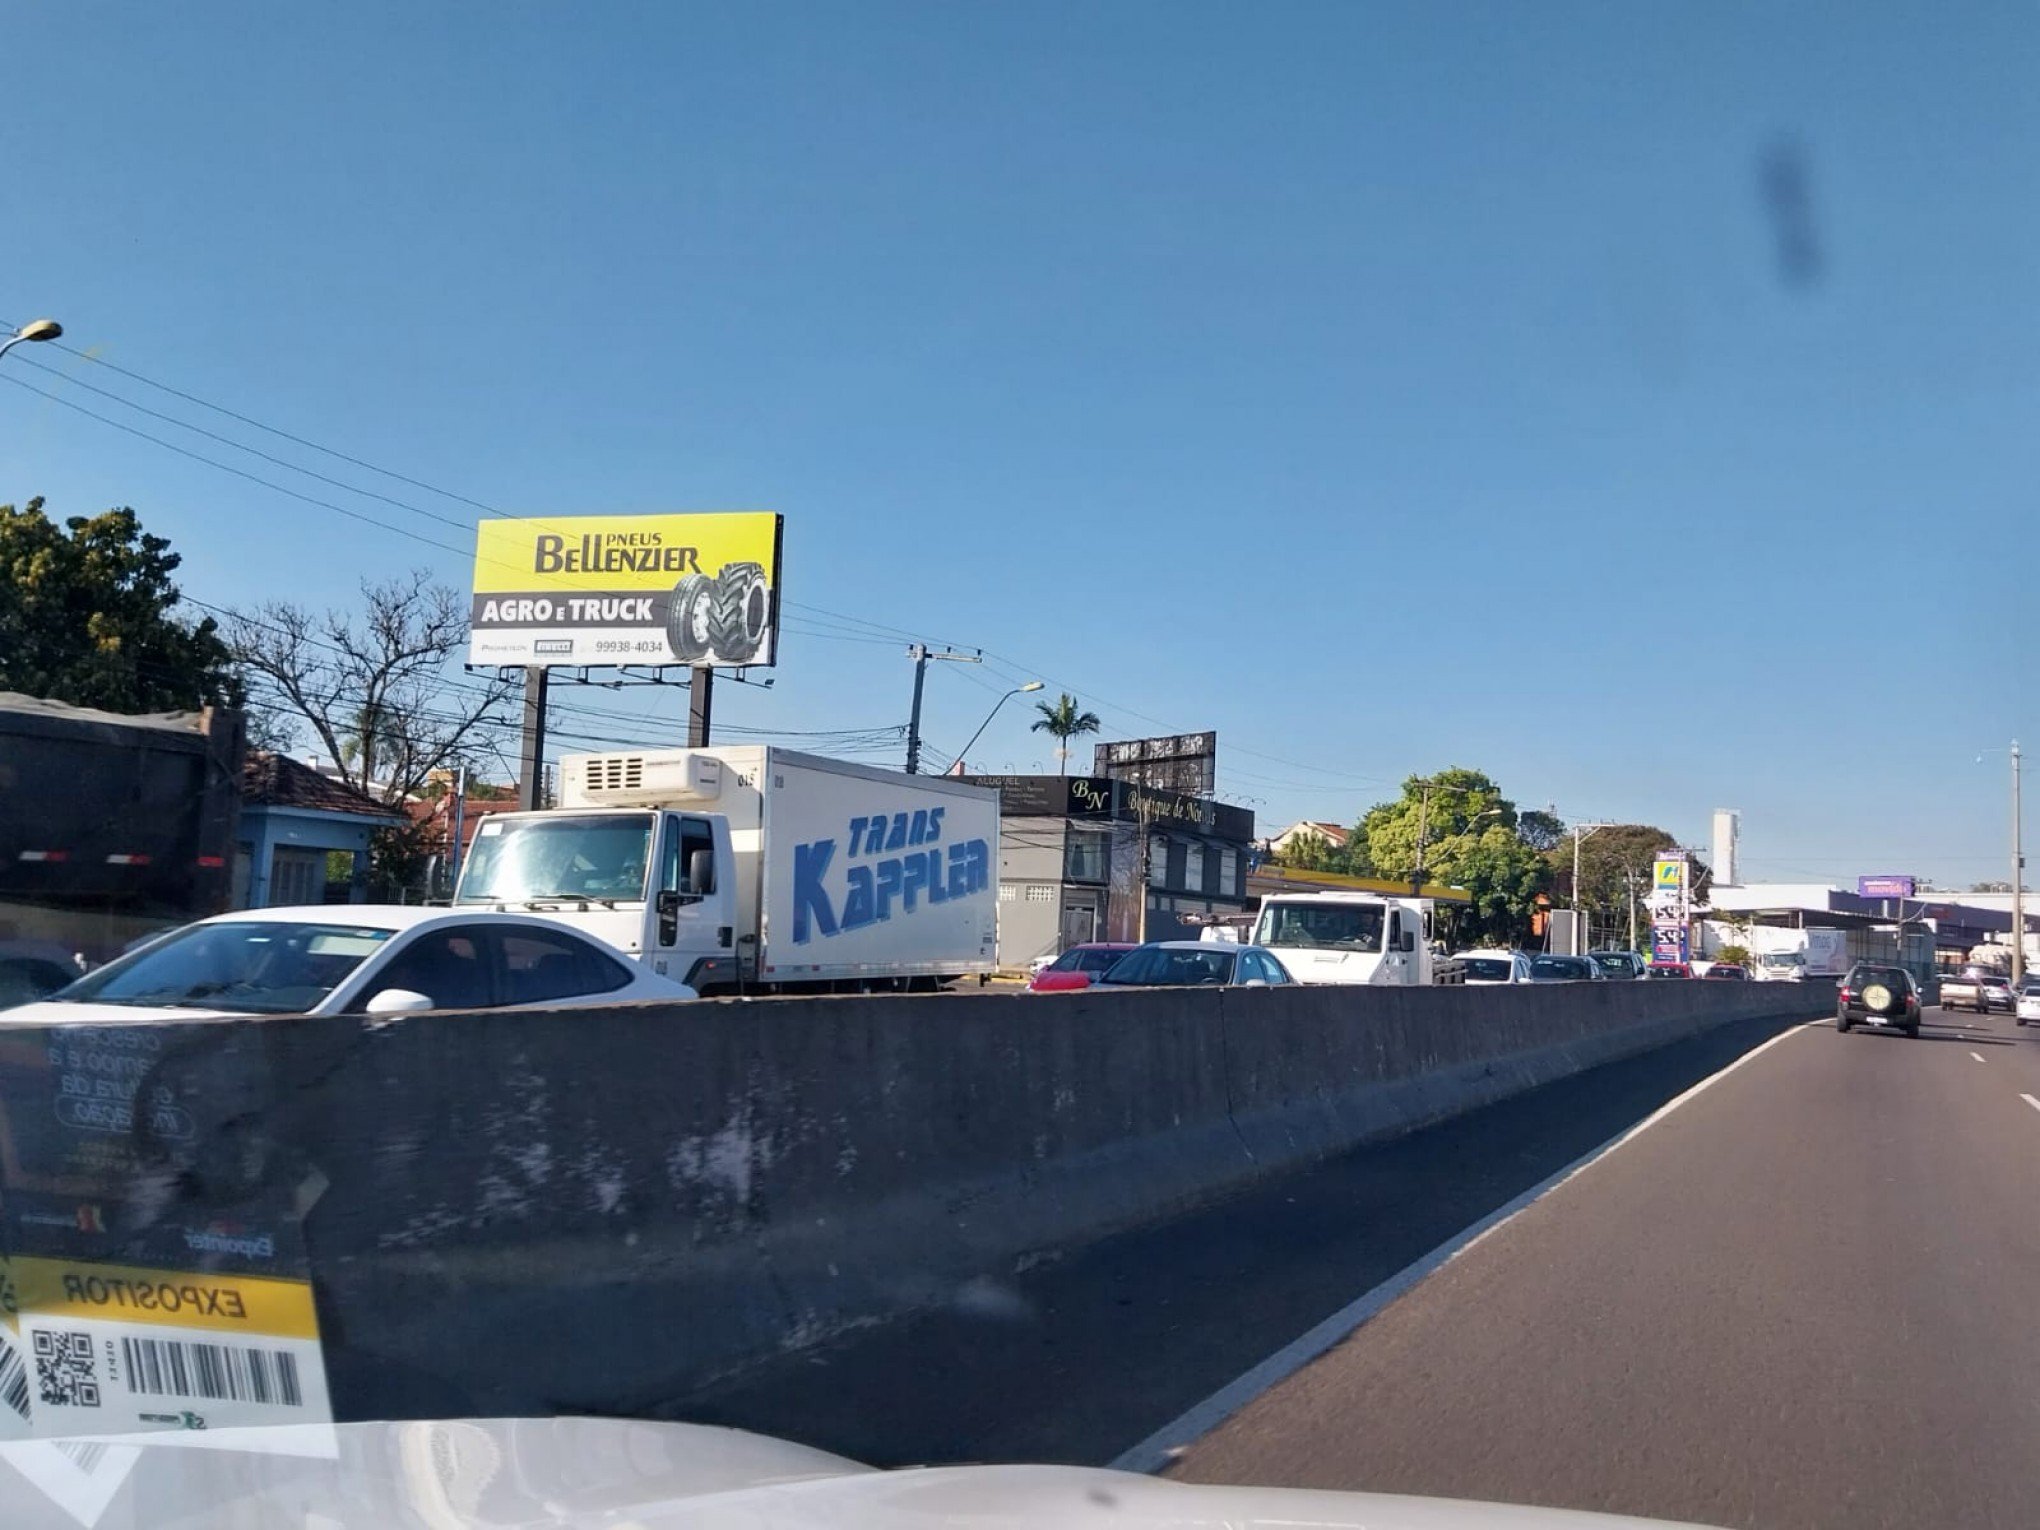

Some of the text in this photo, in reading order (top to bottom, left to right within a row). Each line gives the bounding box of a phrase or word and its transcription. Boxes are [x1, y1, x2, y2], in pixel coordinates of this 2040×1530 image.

[606, 532, 662, 546] PNEUS
[481, 598, 654, 622] AGRO E TRUCK
[595, 640, 663, 653] 99938-4034
[1172, 796, 1183, 818] de
[1186, 801, 1216, 827] Nos
[848, 806, 946, 858] TRANS
[793, 838, 989, 945] KAPPLER
